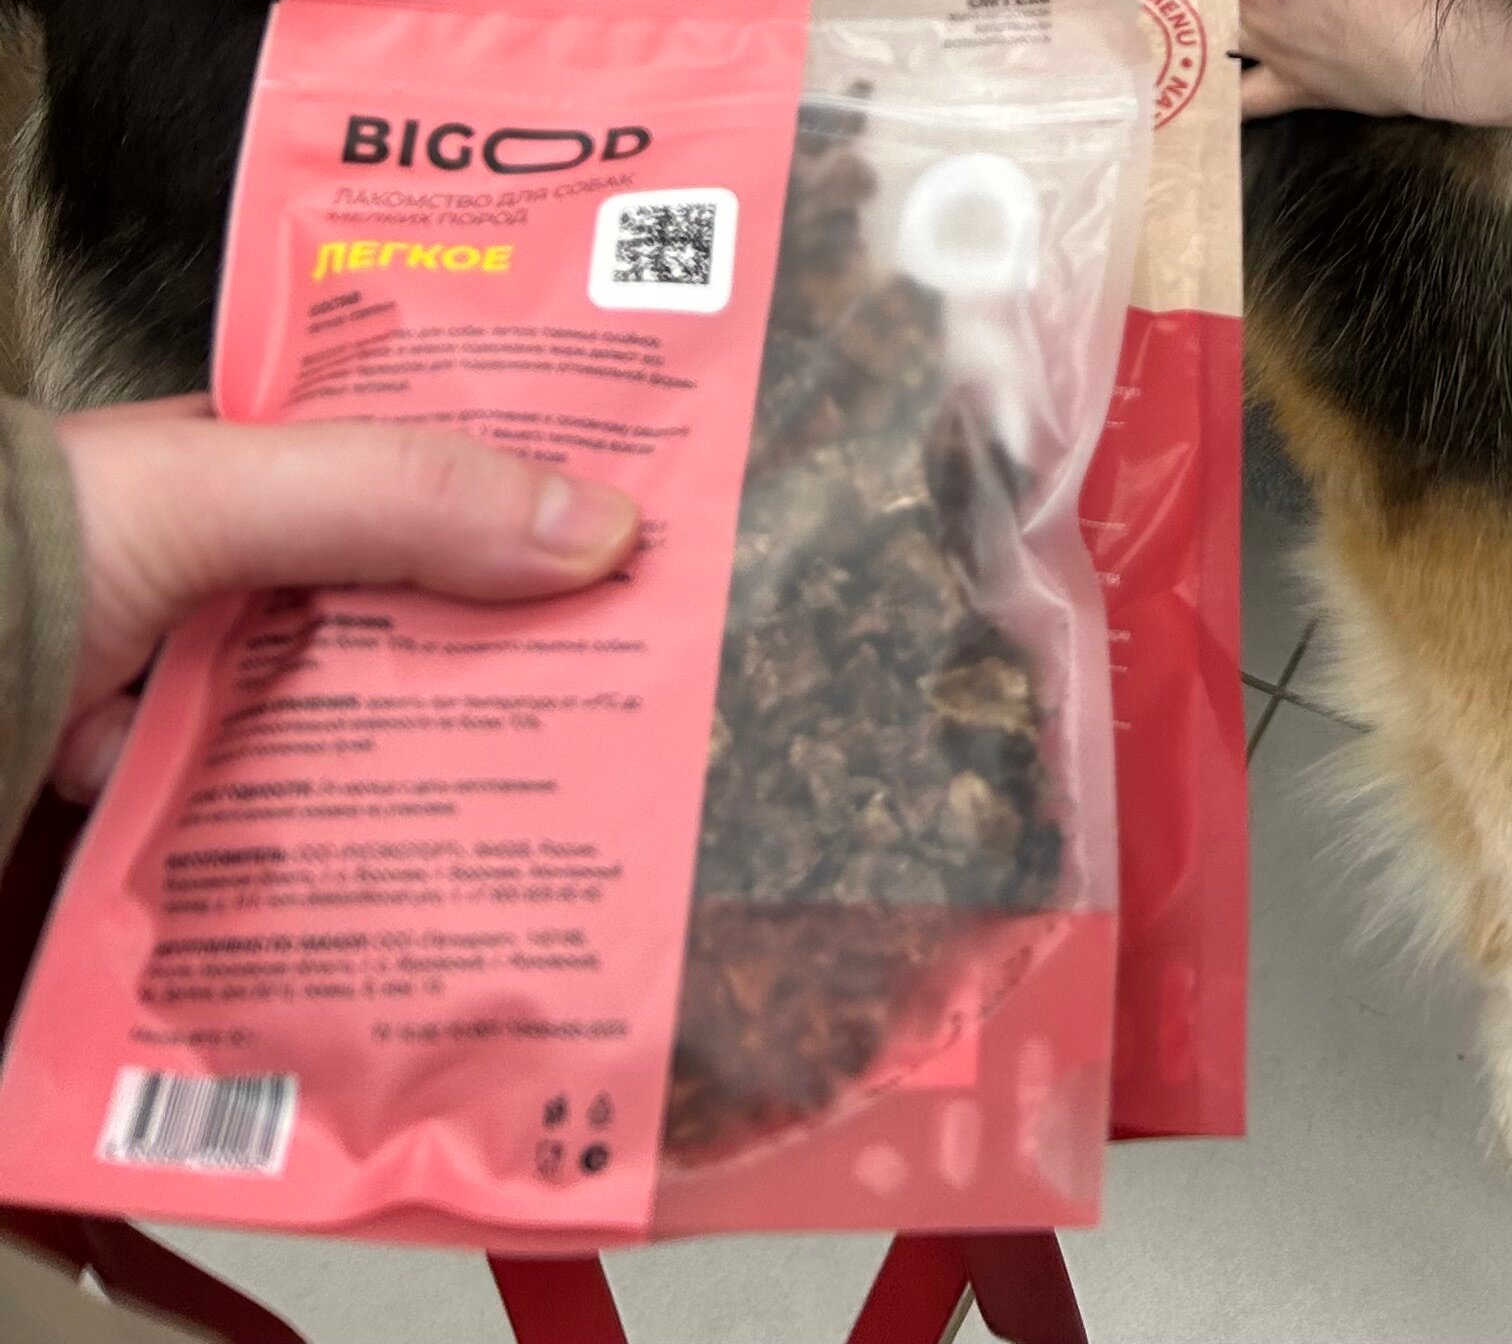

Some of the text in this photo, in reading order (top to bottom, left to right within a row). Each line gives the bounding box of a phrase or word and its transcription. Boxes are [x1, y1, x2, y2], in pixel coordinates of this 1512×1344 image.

[332, 173, 635, 211] ЛАКОМСТВО ДЛЯ СОБАК
[437, 208, 529, 225] ПОРОД
[312, 240, 515, 282] ЛЕГКОЕ
